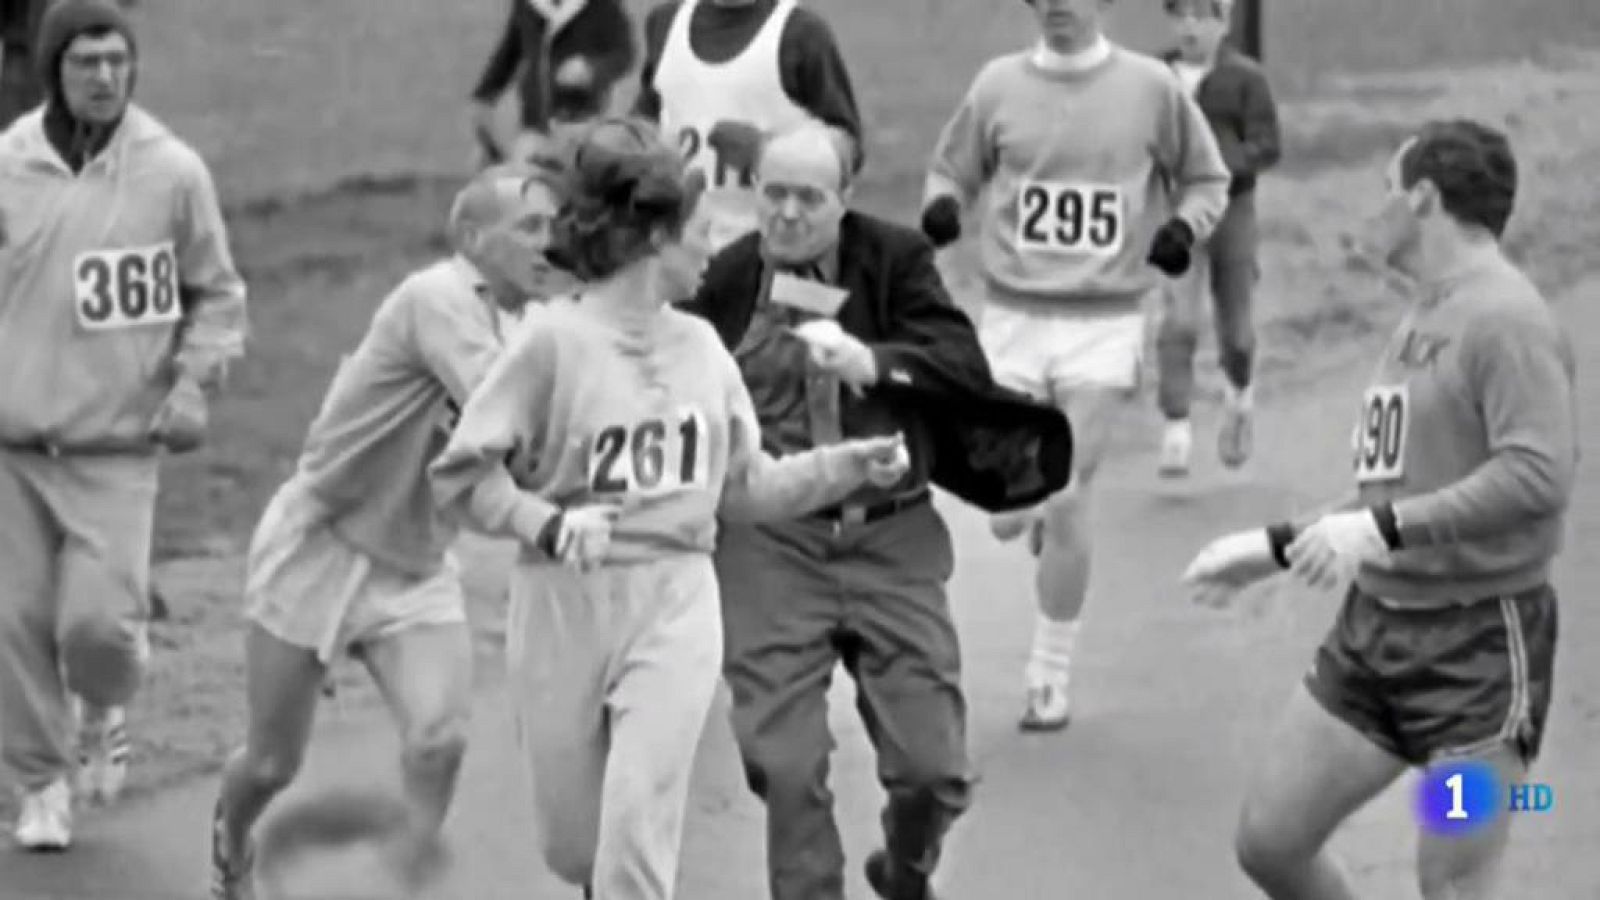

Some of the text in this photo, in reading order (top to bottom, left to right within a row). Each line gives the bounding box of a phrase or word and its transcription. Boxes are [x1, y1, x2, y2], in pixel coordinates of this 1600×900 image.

[1023, 186, 1118, 247] 295
[78, 250, 173, 322] 368
[592, 413, 698, 492] 261
